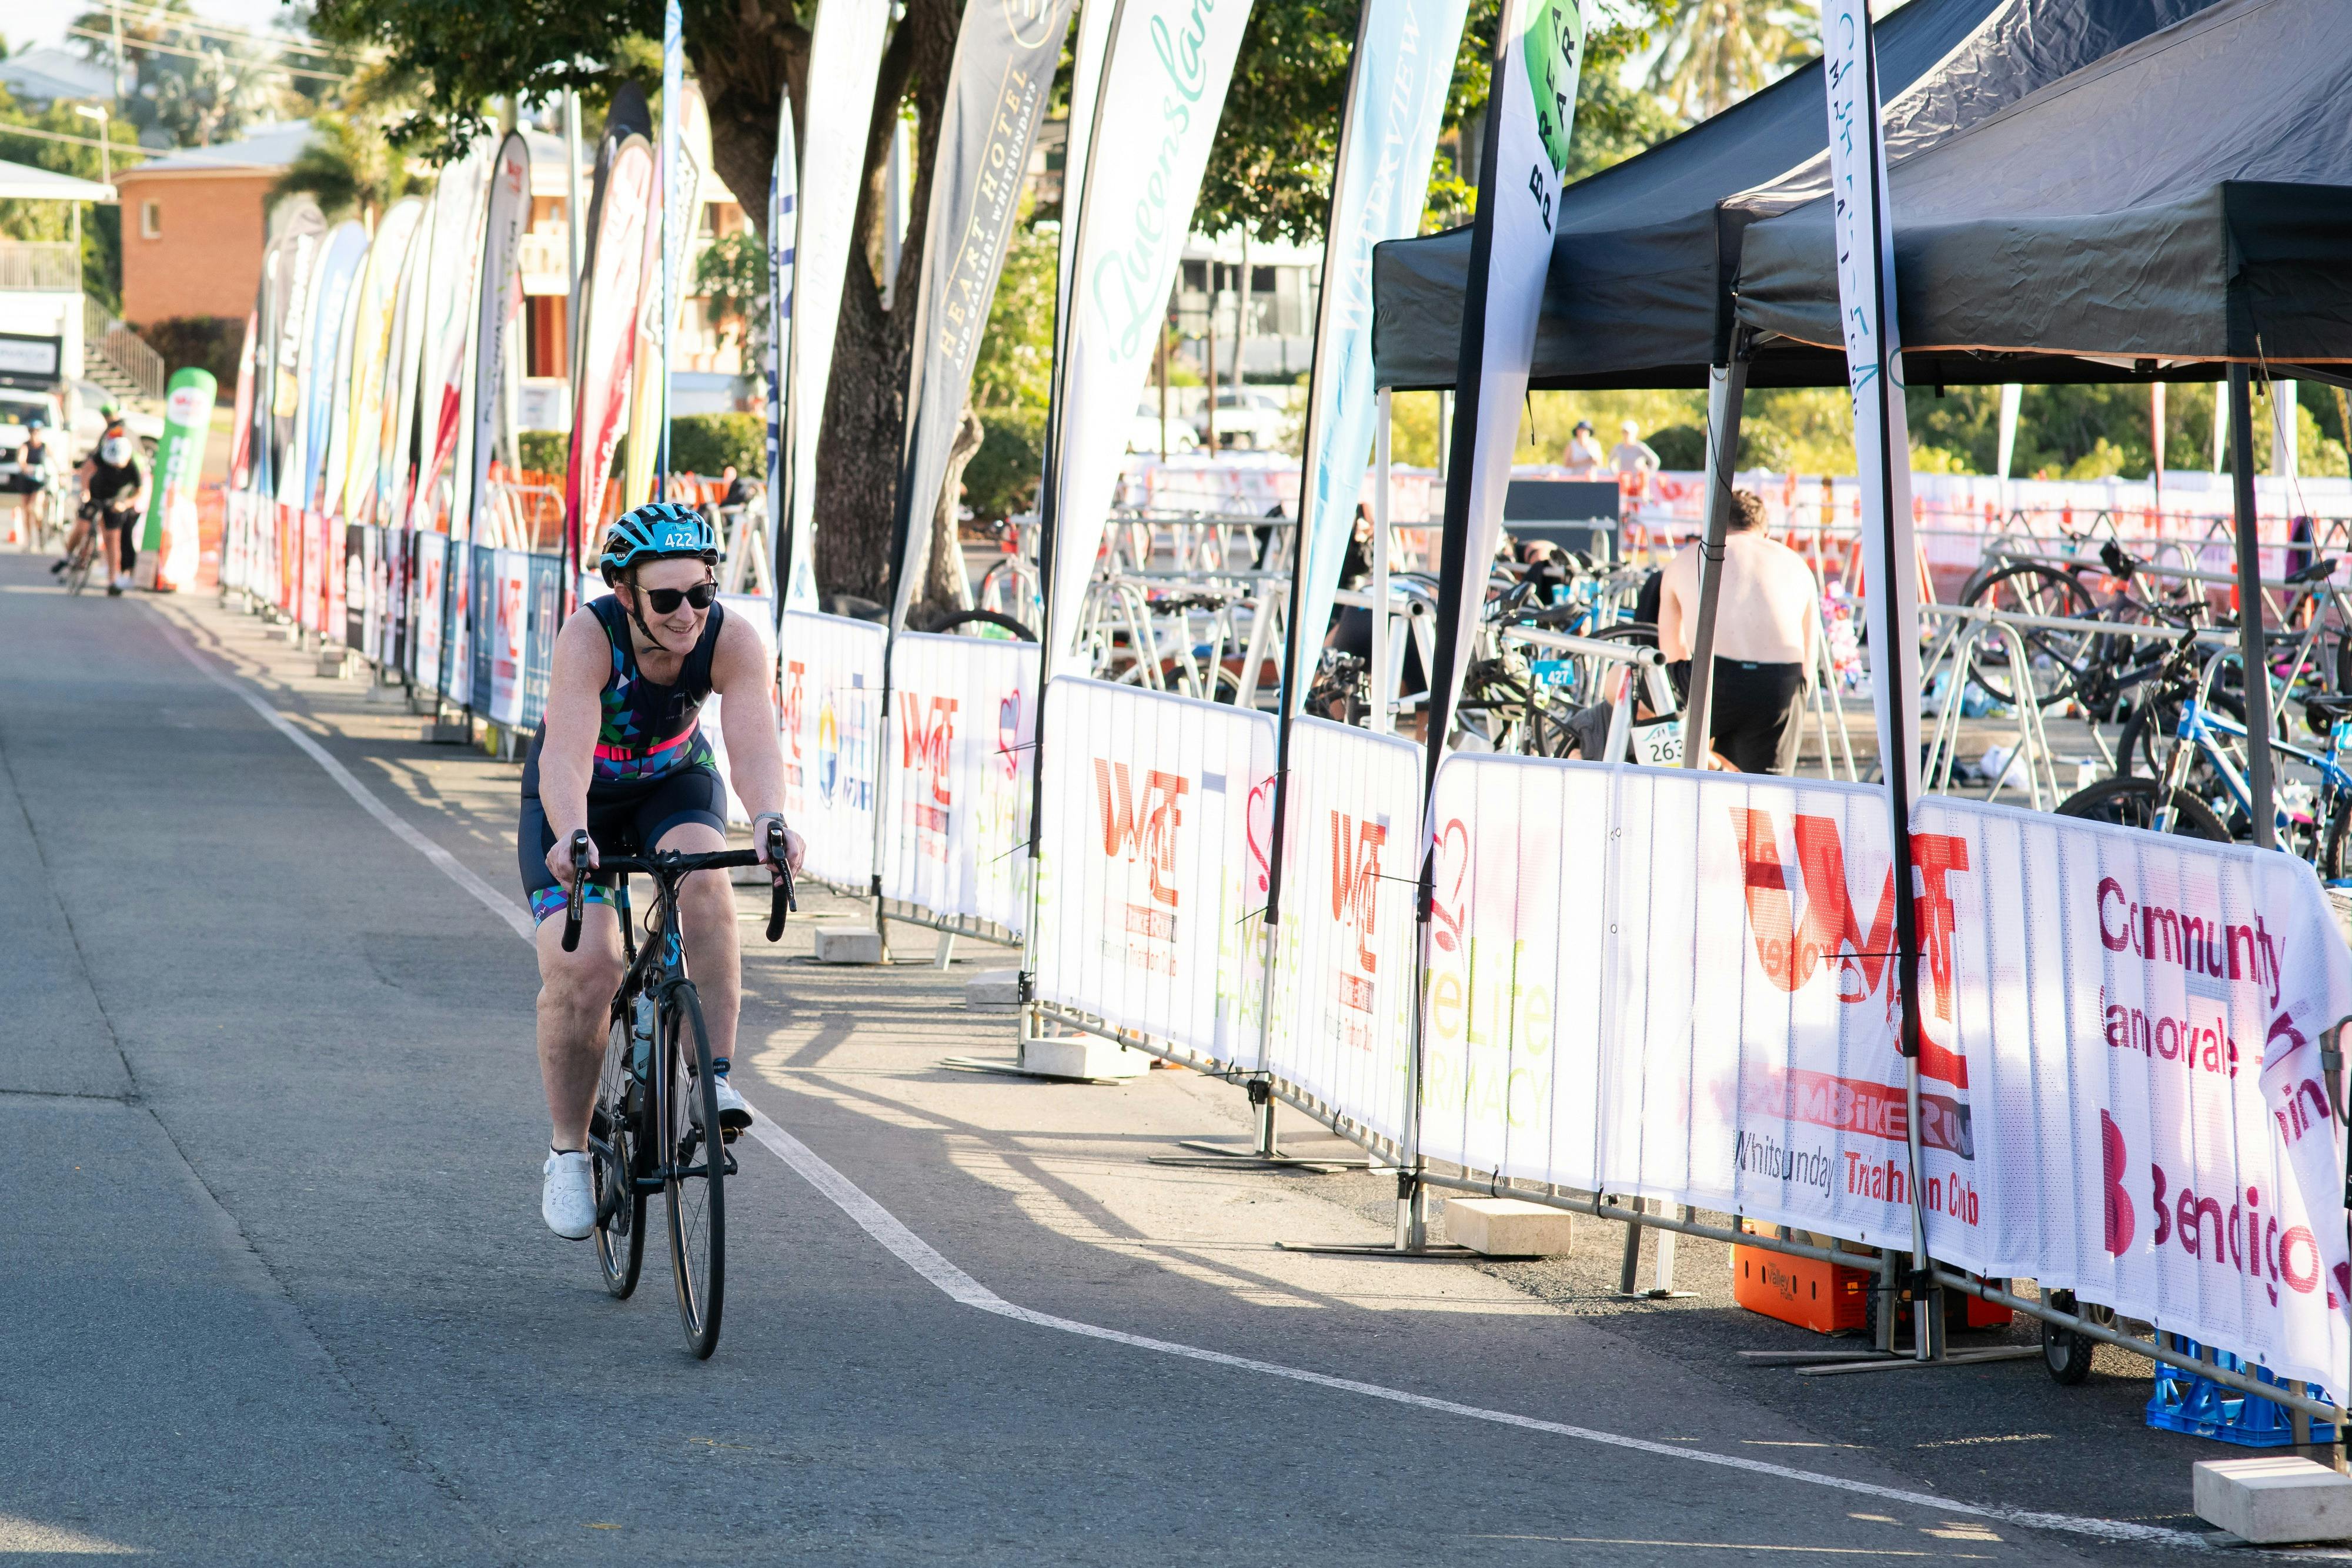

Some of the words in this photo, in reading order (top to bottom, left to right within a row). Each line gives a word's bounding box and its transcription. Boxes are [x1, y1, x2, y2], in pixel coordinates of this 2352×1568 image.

[992, 81, 1036, 222] WHITSUNDAYS
[940, 215, 985, 359] HEART
[980, 69, 1027, 203] HOTEL
[664, 533, 694, 548] 422
[1547, 670, 1569, 684] 427
[780, 860, 793, 899] ULTEGRA
[1845, 1151, 1942, 1212] Triathln
[1949, 1171, 1979, 1227] Club
[1768, 1268, 1790, 1292] Valley
